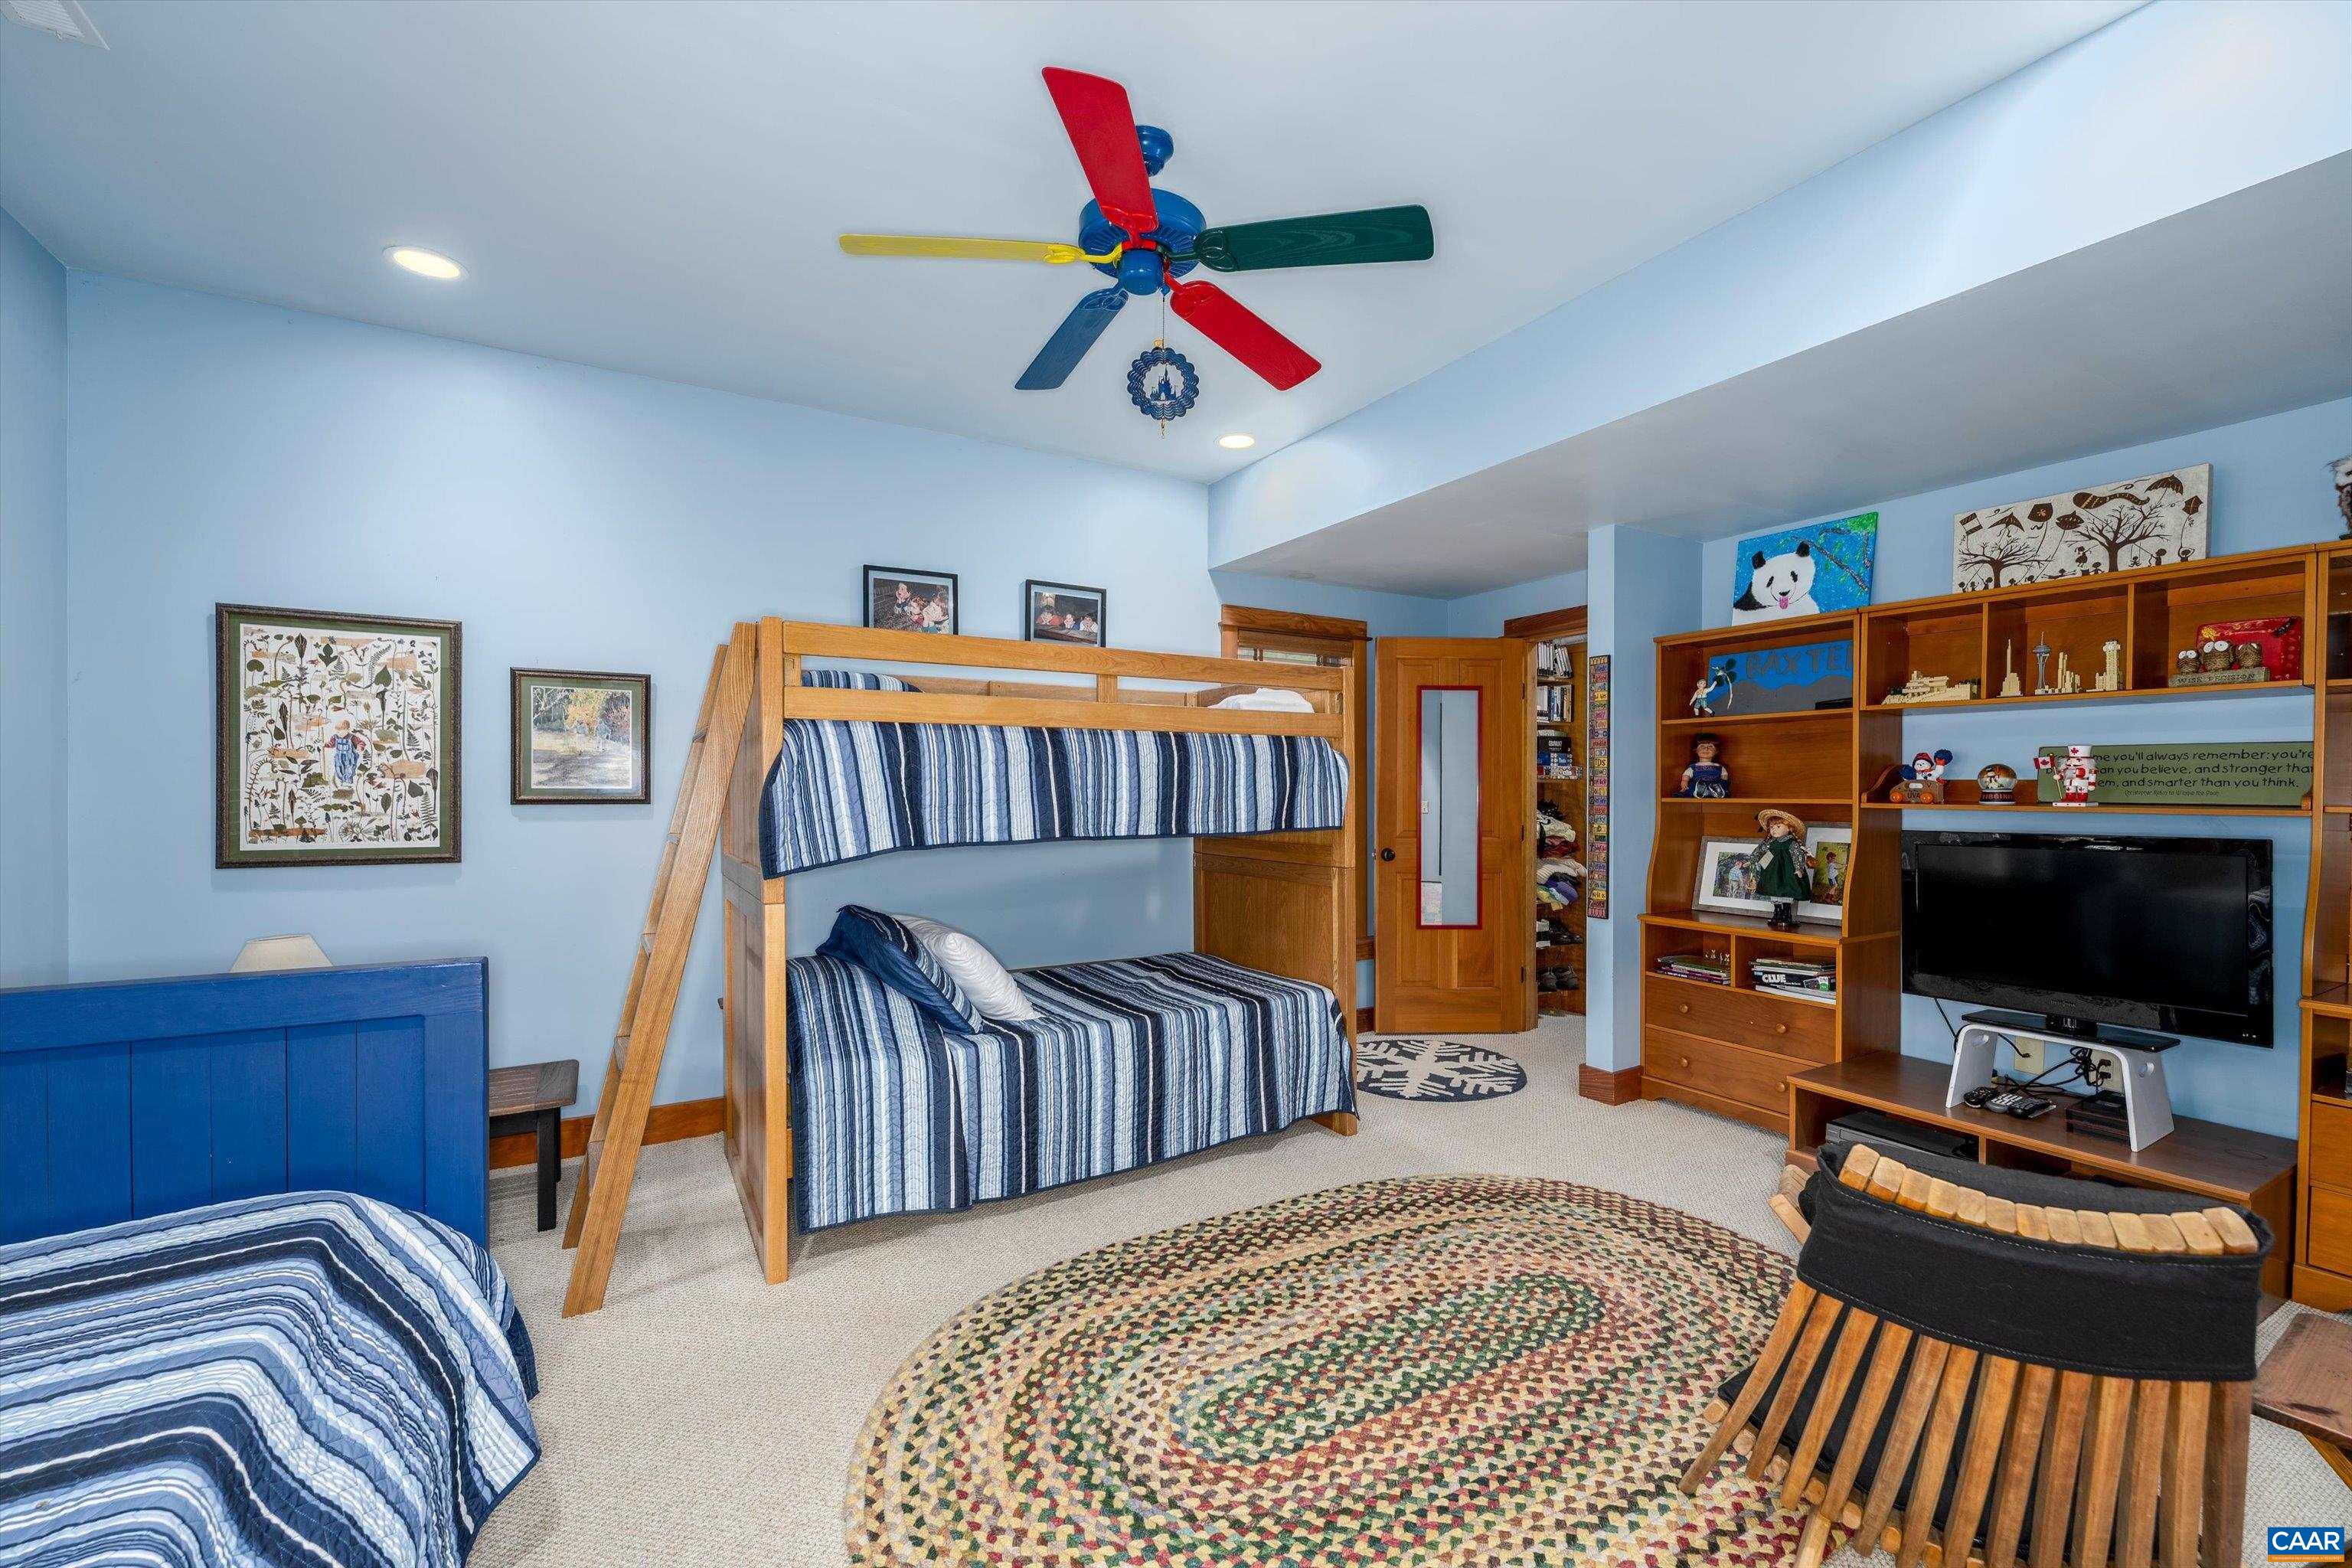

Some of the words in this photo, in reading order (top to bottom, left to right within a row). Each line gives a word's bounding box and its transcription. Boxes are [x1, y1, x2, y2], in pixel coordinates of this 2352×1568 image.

[2113, 753, 2144, 763] you'll
[2146, 750, 2189, 763] always
[2193, 749, 2269, 760] remember:
[2141, 764, 2191, 775] believe,
[2194, 763, 2220, 773] and
[2222, 763, 2283, 776] stronger
[2122, 777, 2145, 788] and
[2147, 776, 2199, 788] smarter
[2200, 777, 2231, 788] than
[2233, 779, 2259, 789] you
[2262, 776, 2299, 788] think.
[1762, 974, 1787, 983] CLUE
